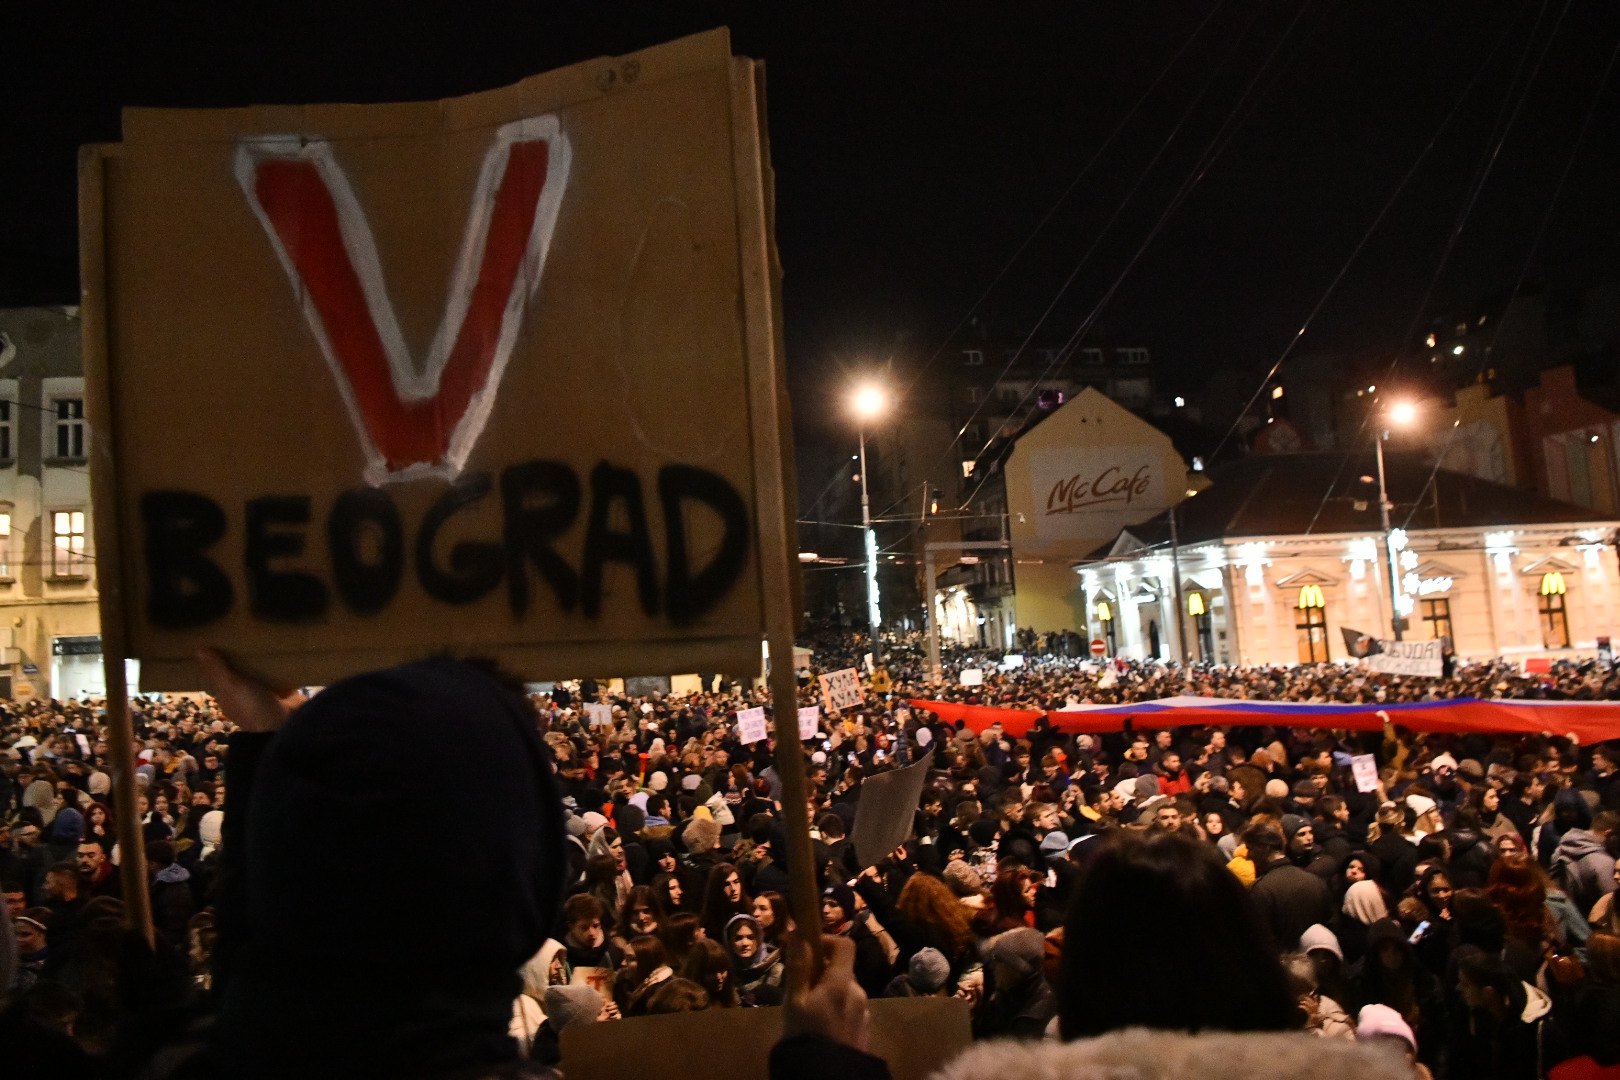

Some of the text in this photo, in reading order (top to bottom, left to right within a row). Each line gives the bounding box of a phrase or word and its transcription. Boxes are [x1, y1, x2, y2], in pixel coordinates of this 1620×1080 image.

[234, 114, 572, 486] V
[141, 459, 751, 628] BEOGRAD
[1046, 465, 1150, 514] McCafé
